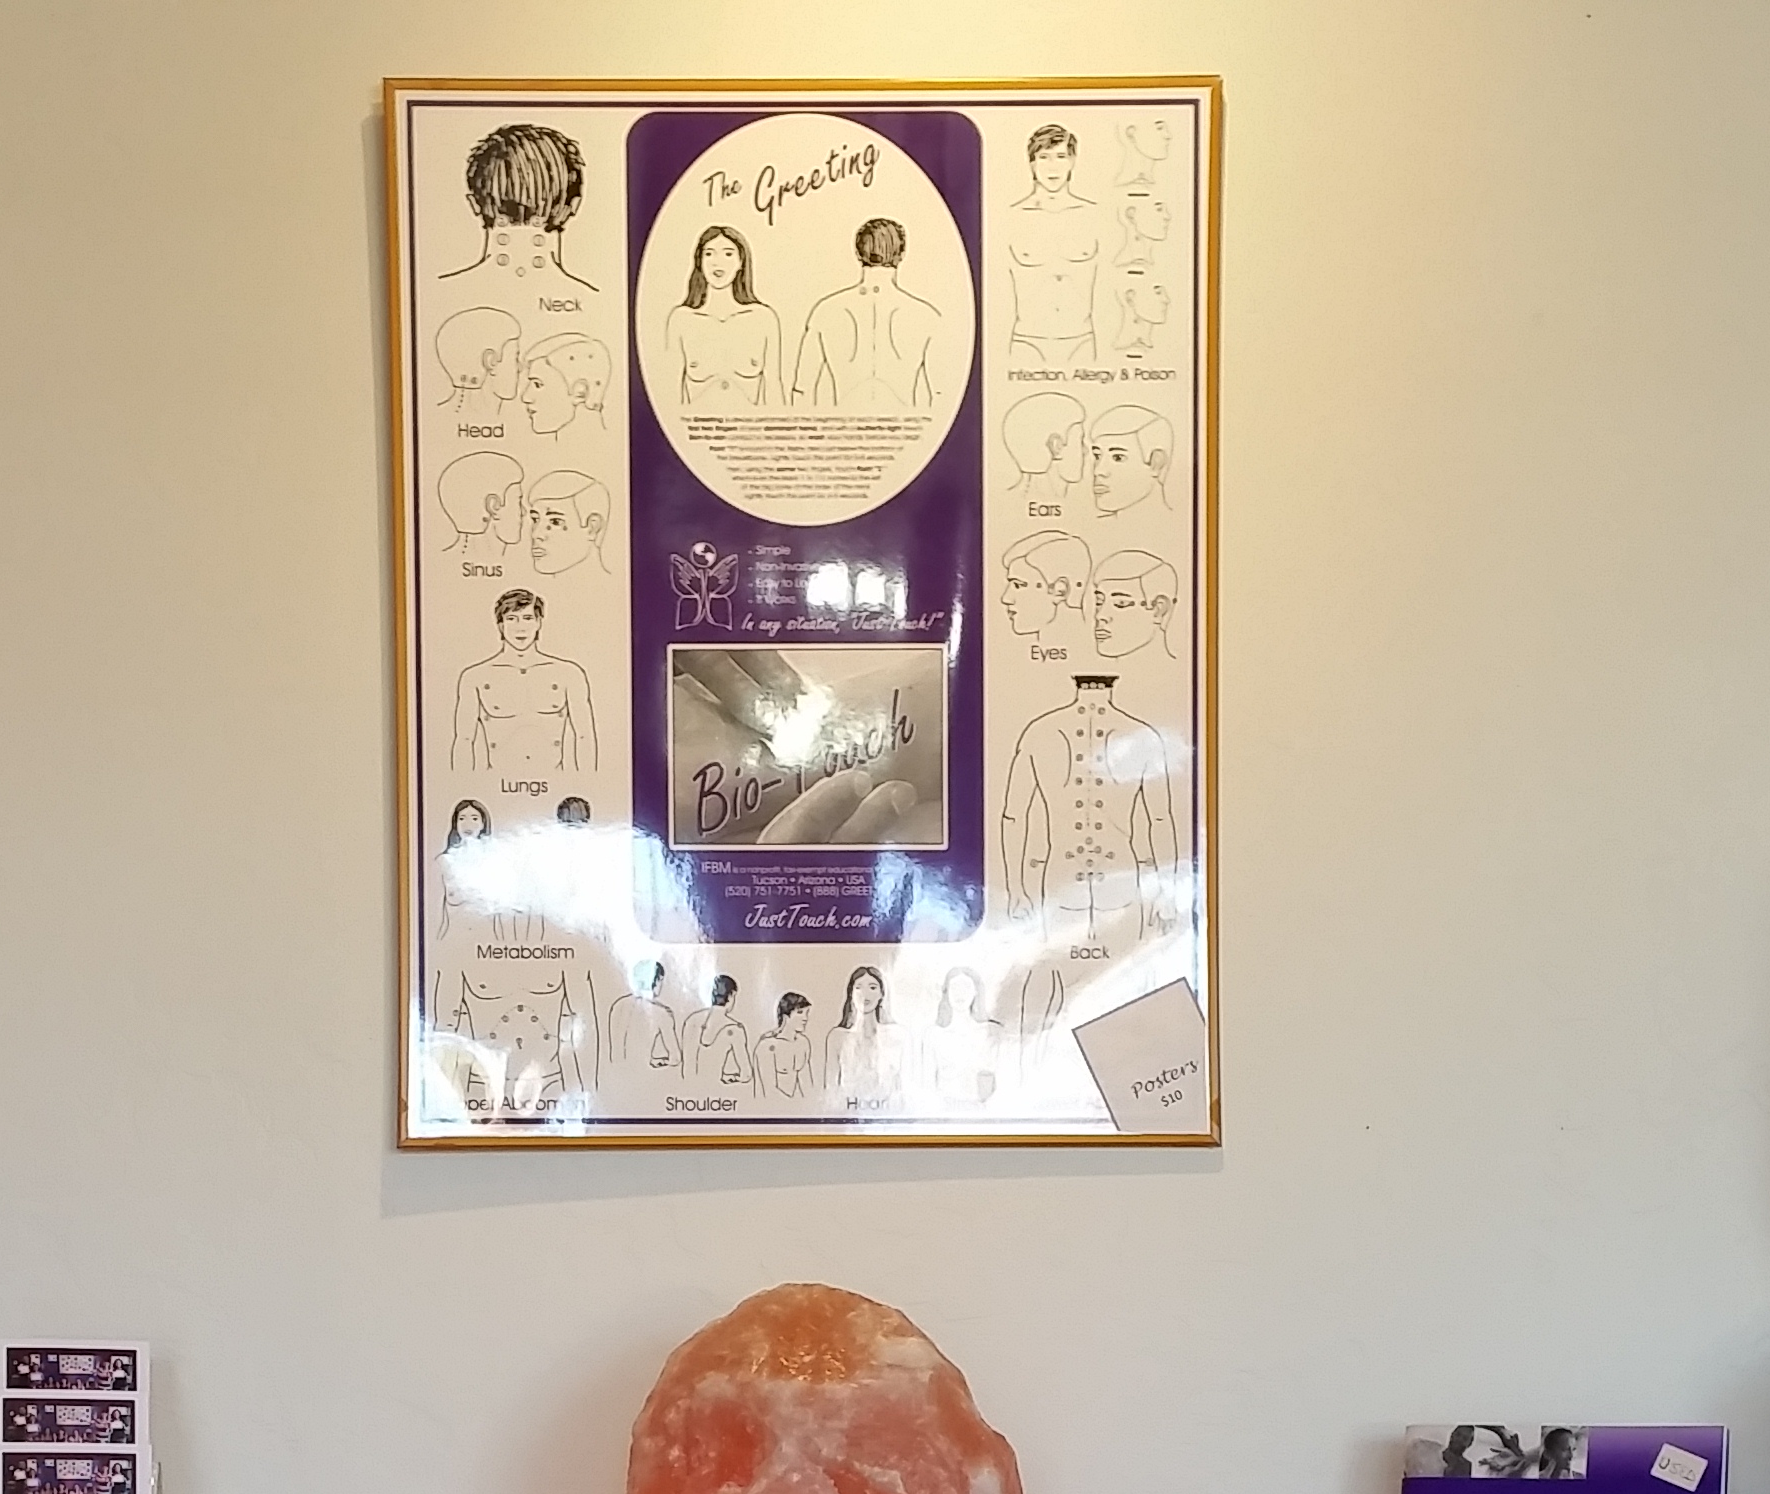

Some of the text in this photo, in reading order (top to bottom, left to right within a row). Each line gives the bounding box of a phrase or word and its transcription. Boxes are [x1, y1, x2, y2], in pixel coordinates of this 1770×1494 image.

[702, 142, 881, 226] The Greeting
[538, 297, 582, 313] Neck
[1007, 368, 1069, 382] Infection,
[1071, 368, 1117, 385] Allergy
[1133, 367, 1177, 382] Poison
[457, 423, 505, 439] Head
[1028, 501, 1062, 517] Ears
[461, 561, 503, 578] Sinus
[1030, 644, 1068, 663] Eyes
[501, 778, 549, 797] Lungs
[700, 861, 731, 874] IFBM
[751, 875, 866, 885] Tucson Arizona USA
[744, 902, 873, 930] JustTouch.com
[476, 944, 575, 960] Metabolism
[1070, 945, 1110, 960] Back
[1130, 1060, 1200, 1101] Posters
[665, 1096, 738, 1112] Shoulder
[1160, 1089, 1183, 1108] $10
